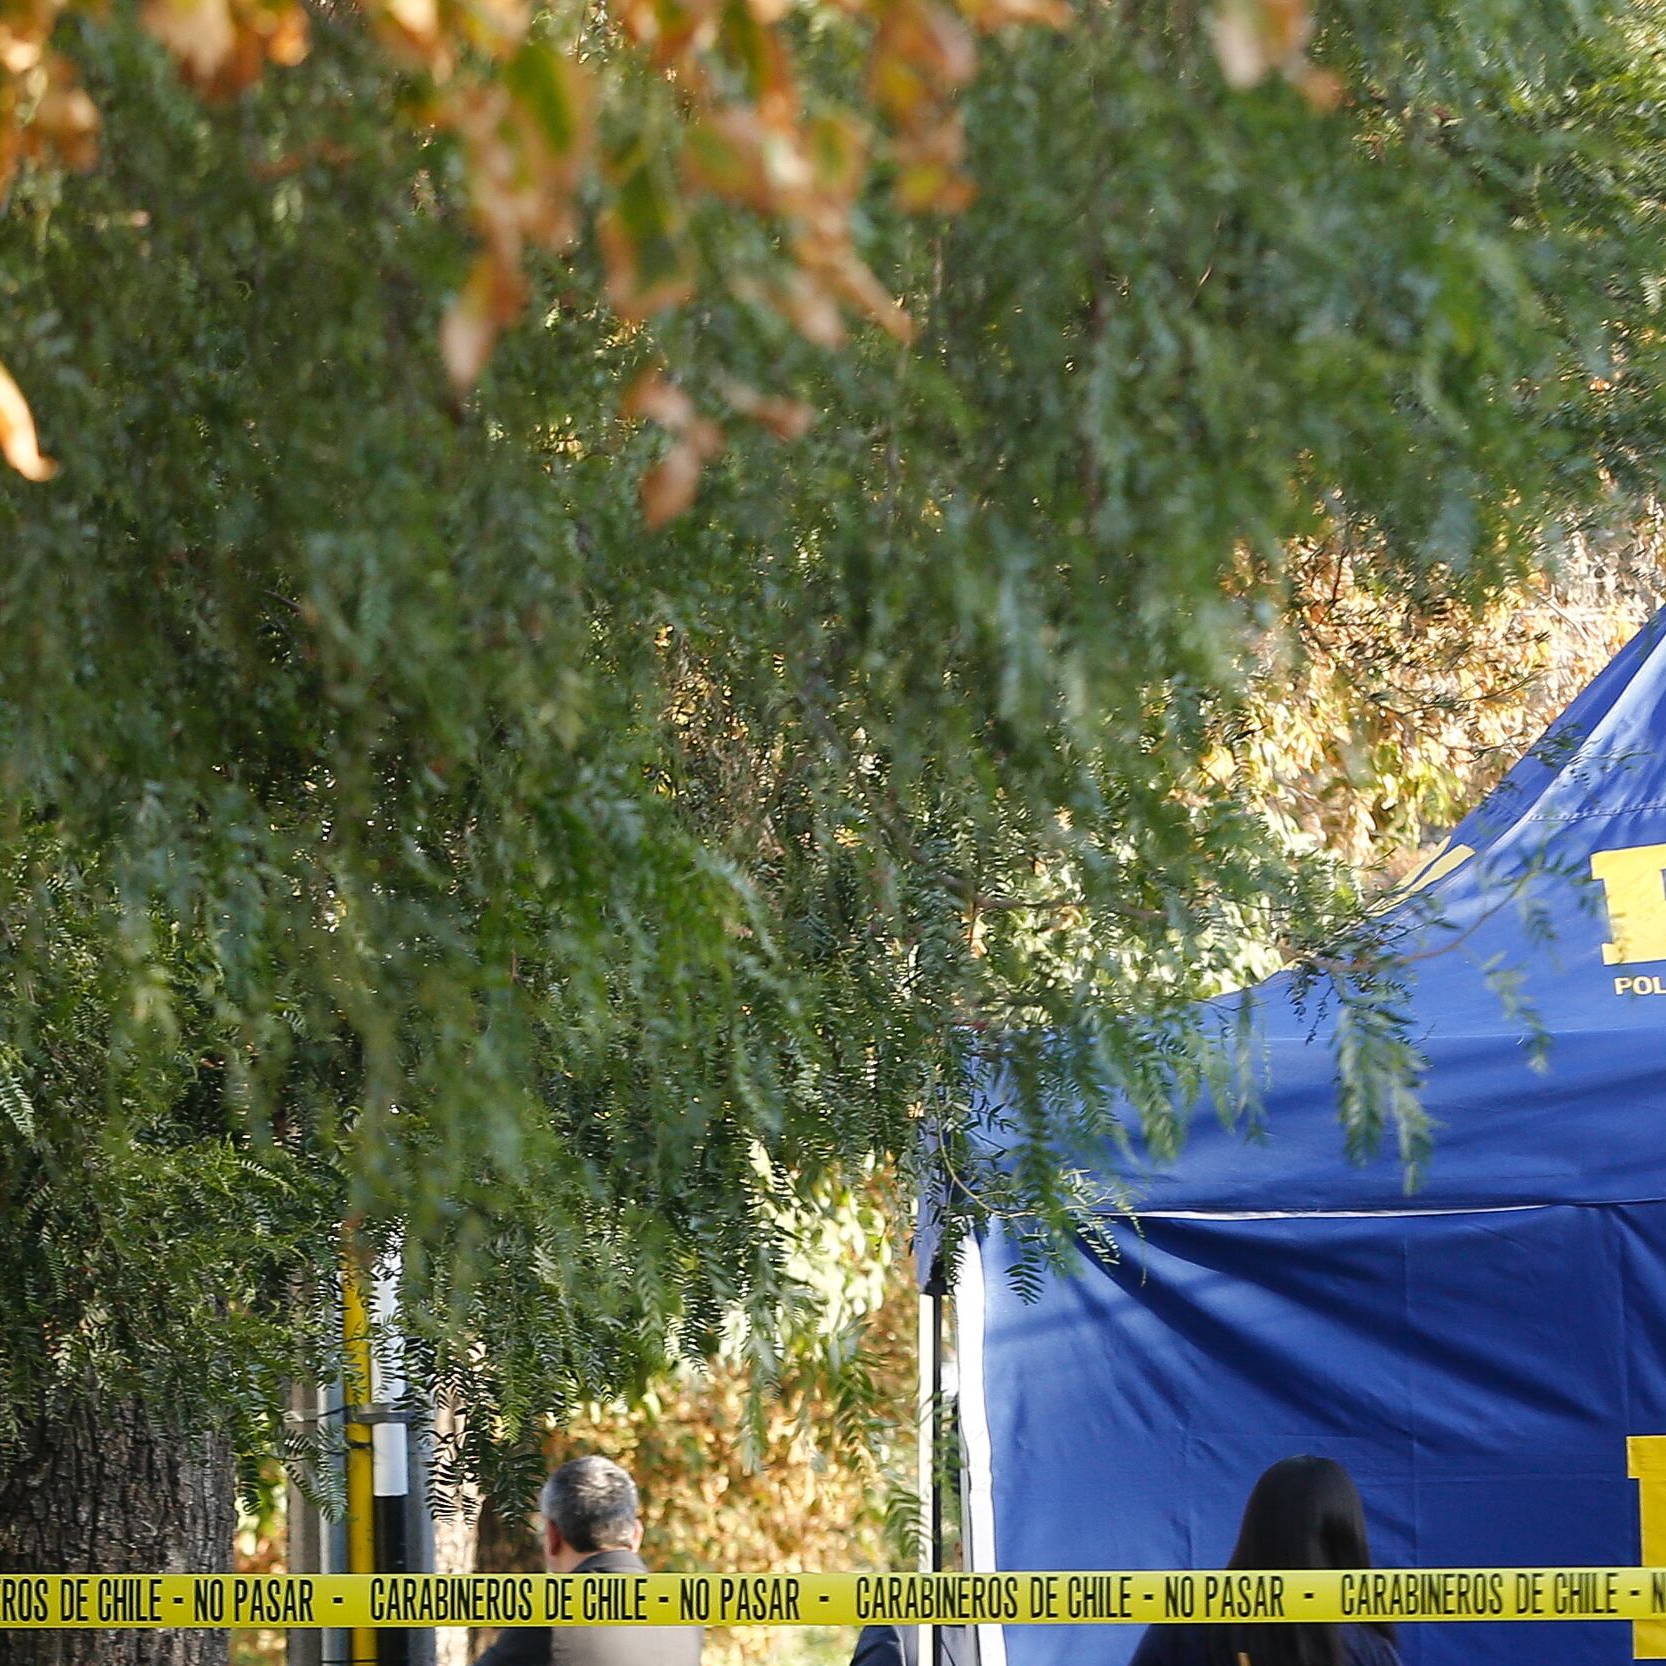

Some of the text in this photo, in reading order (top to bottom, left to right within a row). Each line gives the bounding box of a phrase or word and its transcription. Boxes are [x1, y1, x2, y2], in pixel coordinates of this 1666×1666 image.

[59, 1578, 90, 1623] DE
[96, 1576, 163, 1623] CHILE
[193, 1578, 224, 1623] NO
[233, 1577, 315, 1623] PASAR
[369, 1576, 533, 1622] CARABINEROS
[544, 1577, 574, 1621] DE
[581, 1577, 648, 1621] CHILE
[679, 1576, 710, 1621] NO
[719, 1576, 801, 1621] PASAR
[855, 1575, 1019, 1620] CARABINEROS
[1028, 1576, 1060, 1619] DE
[1066, 1575, 1134, 1619] CHILE
[1163, 1575, 1195, 1619] NO
[1203, 1575, 1286, 1619] PASAR
[1339, 1572, 1504, 1618] CARABINEROS
[1514, 1572, 1545, 1616] DE
[1552, 1572, 1620, 1616] CHILE
